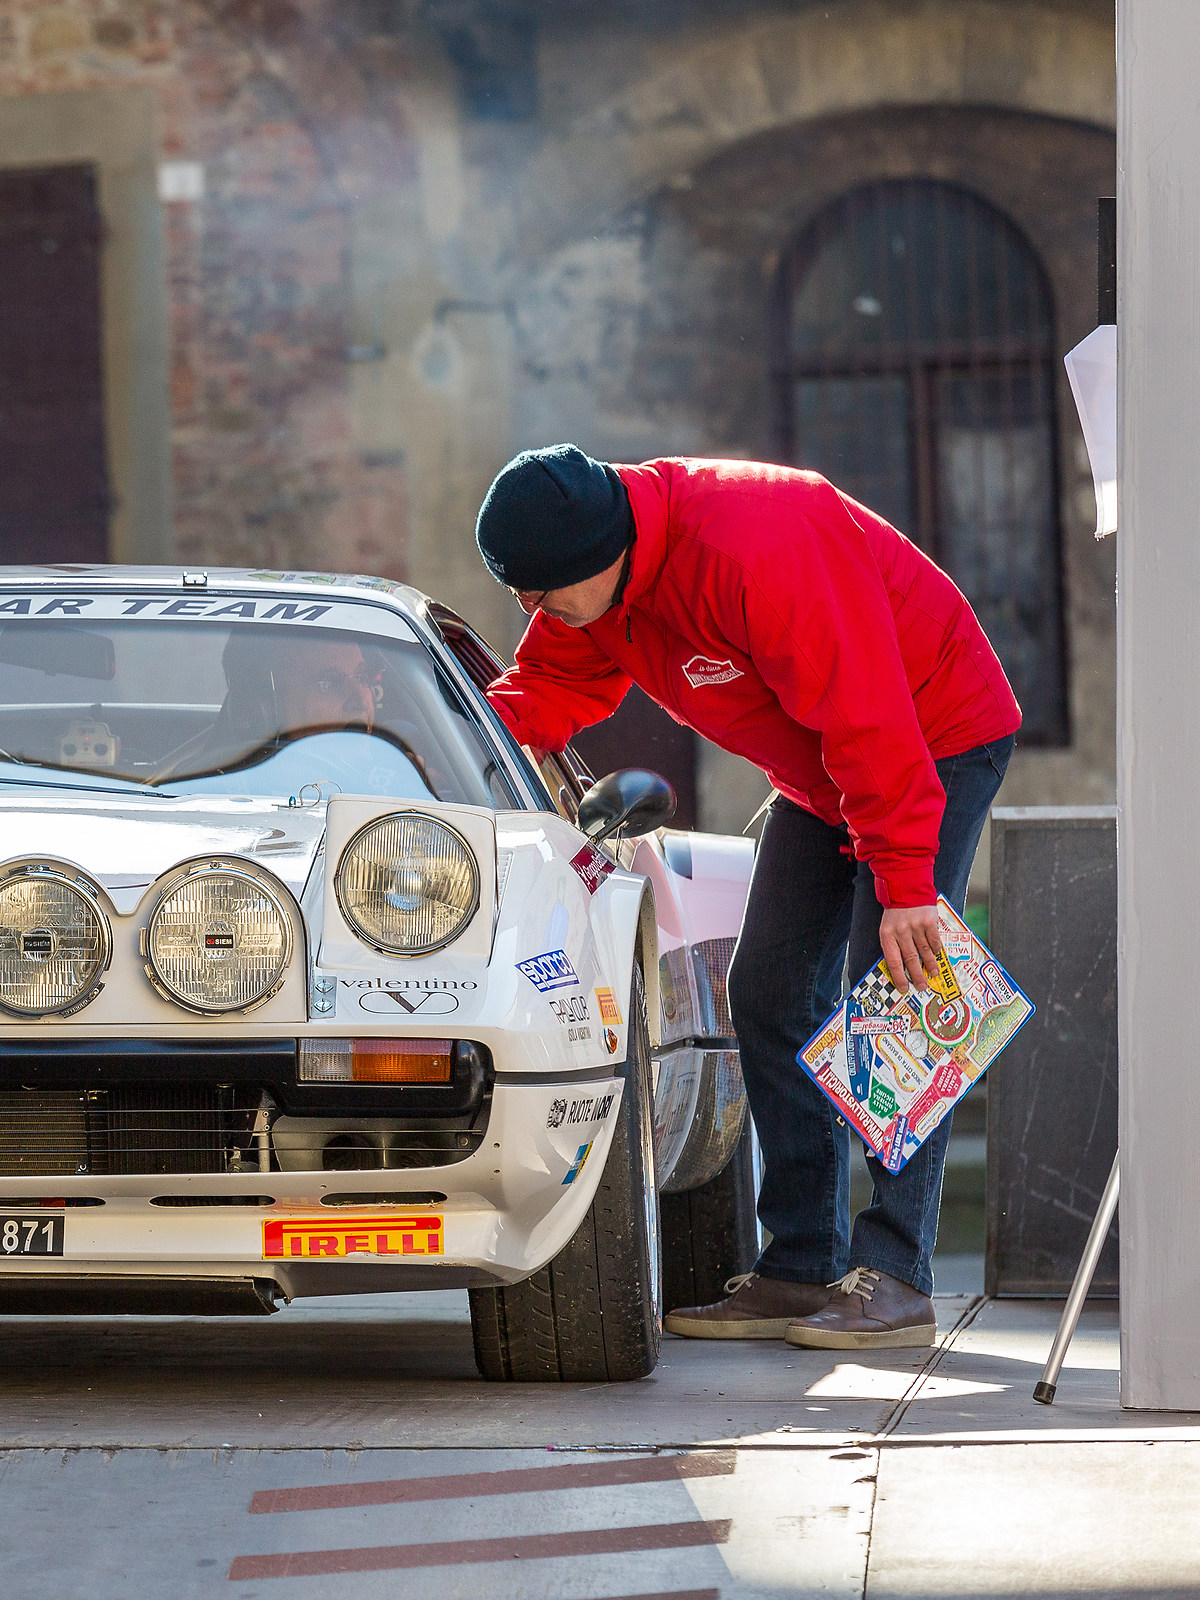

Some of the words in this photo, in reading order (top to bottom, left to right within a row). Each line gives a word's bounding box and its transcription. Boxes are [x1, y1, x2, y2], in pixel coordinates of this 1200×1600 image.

[120, 597, 335, 622] TEAM
[339, 977, 478, 990] valentino
[520, 951, 574, 988] sparco
[805, 1028, 836, 1063] CORALLO
[973, 1025, 1005, 1061] HISTORIC
[1002, 1000, 1025, 1028] RALLY
[882, 1036, 900, 1056] BASSANO
[817, 1067, 884, 1152] WWW.RALLYSTORICI.IT
[873, 1101, 888, 1112] RALLY
[876, 1088, 895, 1101] LIGURE
[264, 1216, 442, 1257] PIRELLI
